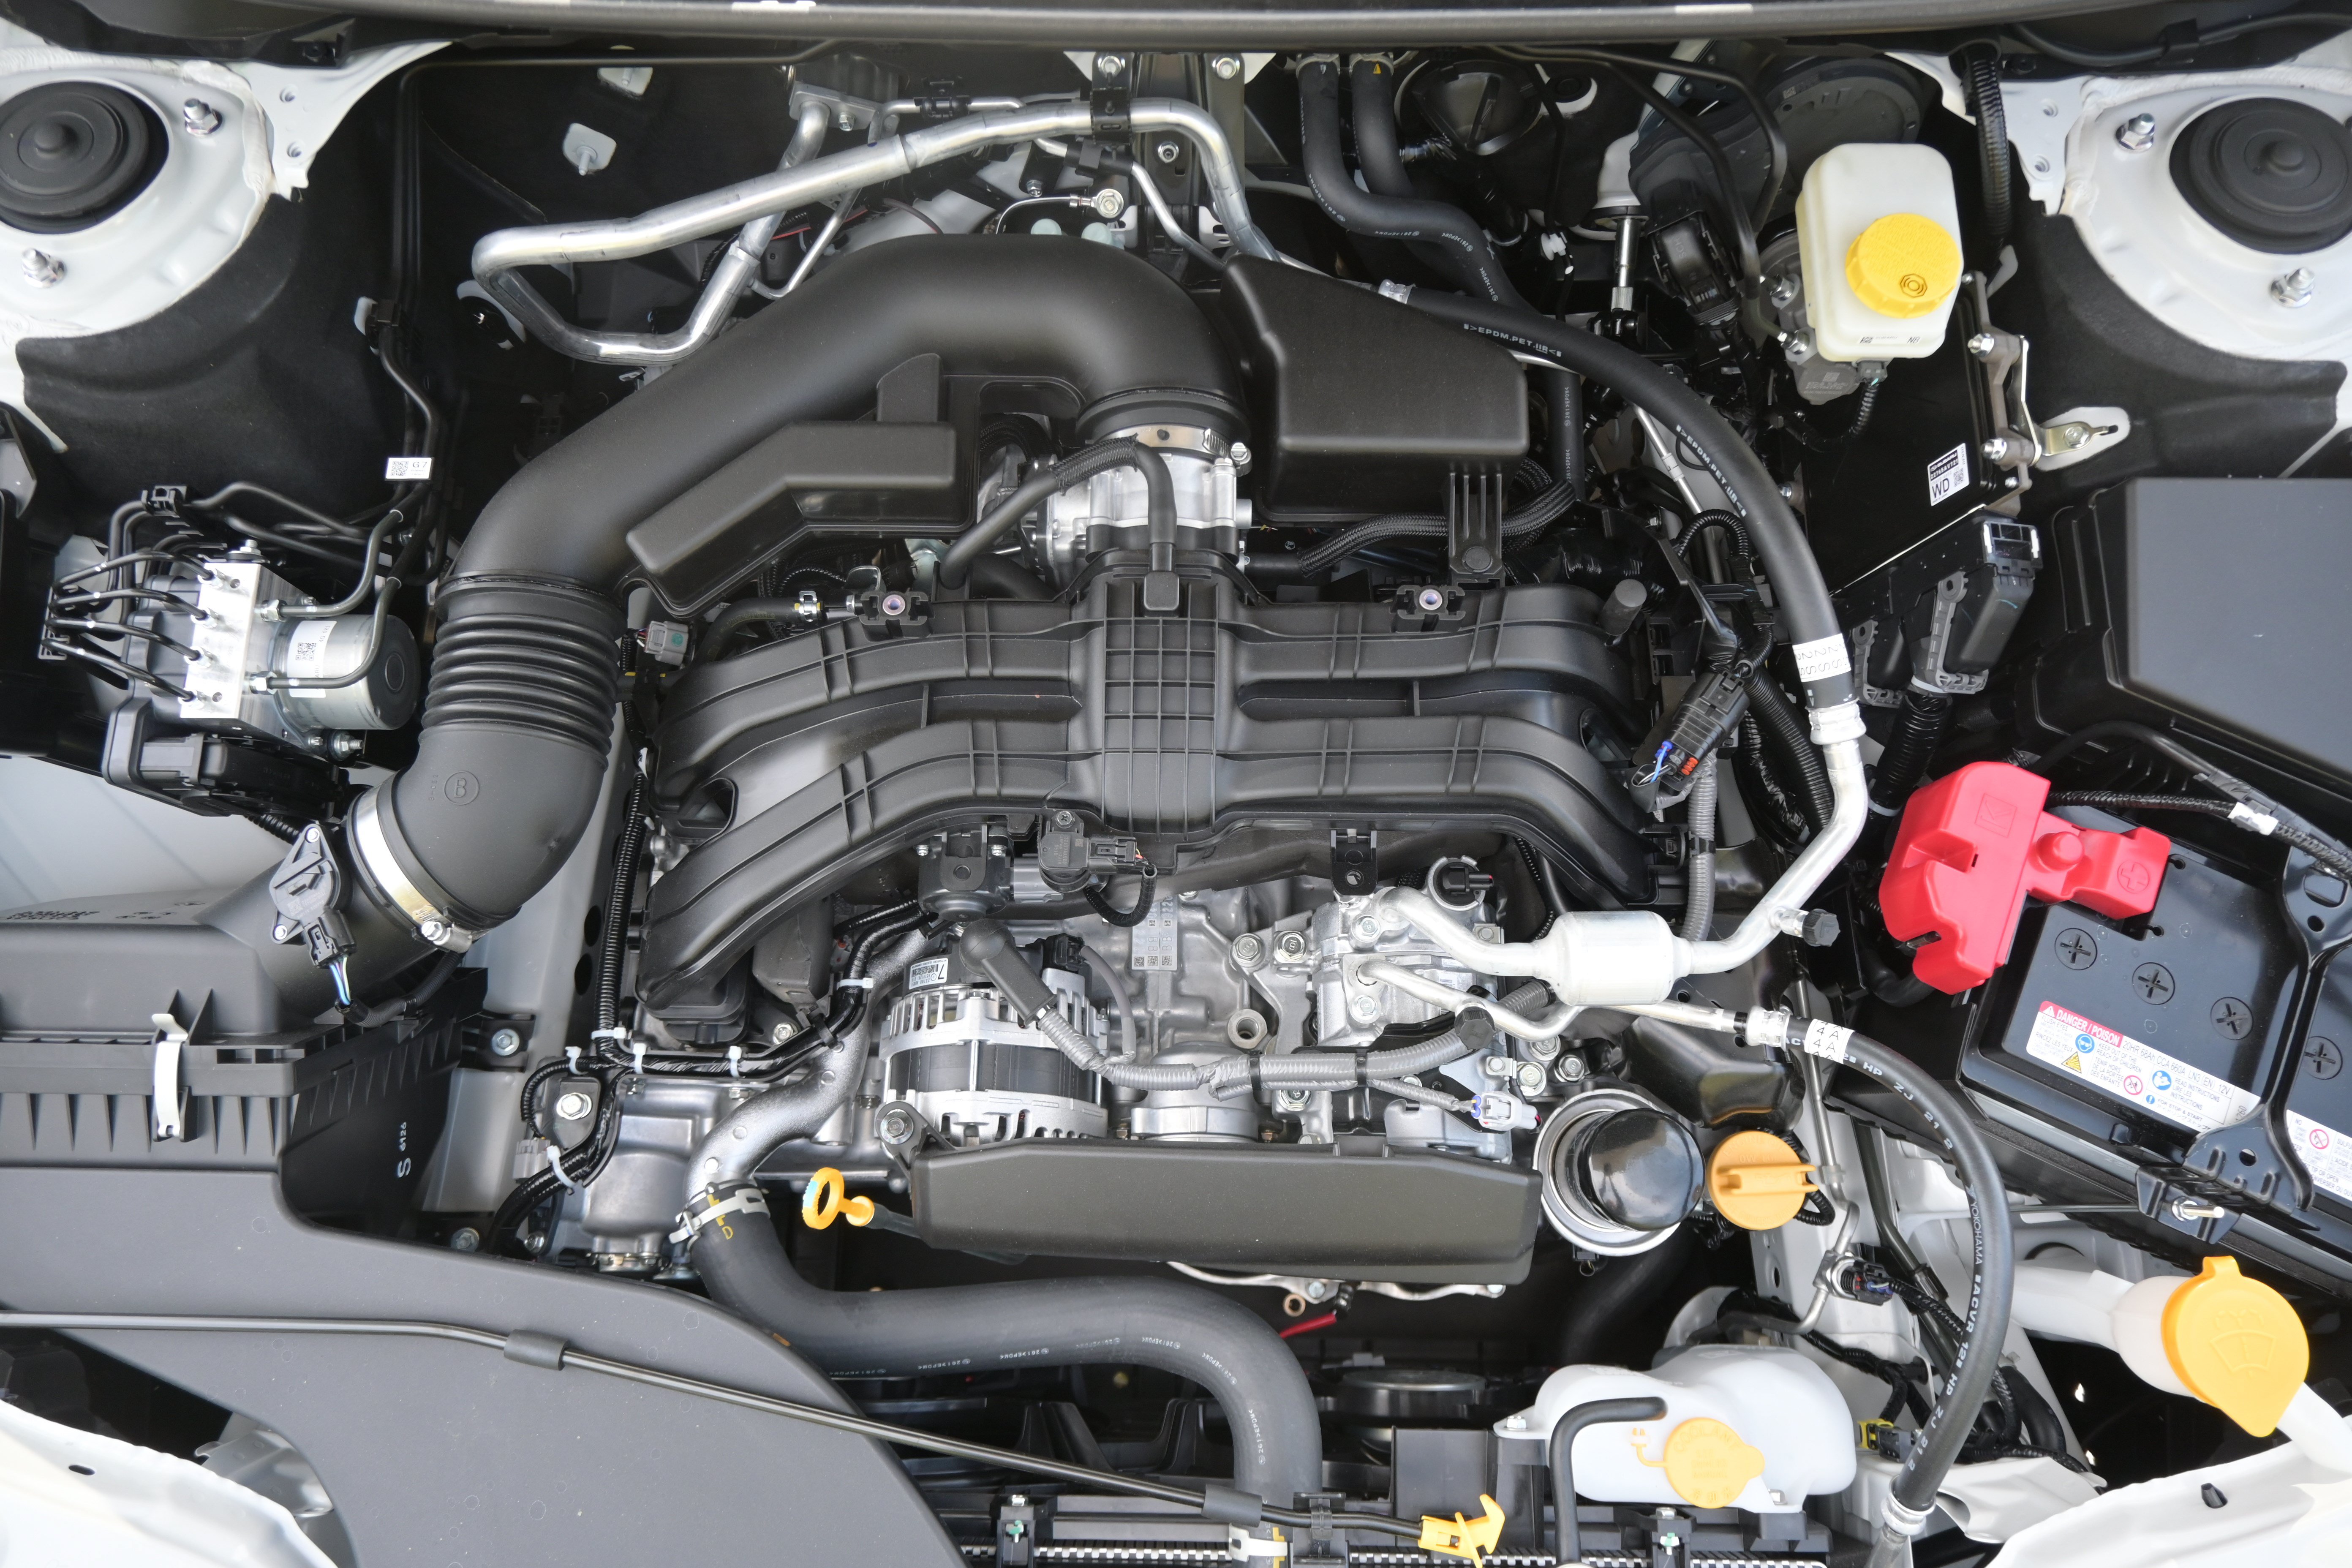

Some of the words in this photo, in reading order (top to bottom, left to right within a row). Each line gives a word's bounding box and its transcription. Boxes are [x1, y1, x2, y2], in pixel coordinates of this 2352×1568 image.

[1932, 478, 1950, 498] WD
[454, 778, 467, 798] B
[937, 964, 945, 980] 7
[2042, 1016, 2055, 1025] FLUSH
[2056, 1010, 2088, 1030] DANGER
[2091, 1026, 2121, 1045] POISON
[2036, 1032, 2051, 1042] RINCEZ
[2095, 1058, 2107, 1066] TENIR
[2109, 1064, 2121, 1072] HORS
[2097, 1050, 2111, 1059] REACH
[2120, 1060, 2142, 1072] CHILDREN
[2123, 1041, 2140, 1053] 20HR
[2140, 1049, 2156, 1061] 68Ah
[2156, 1056, 2170, 1067] CCA
[2171, 1063, 2187, 1075] 660A
[2188, 1071, 2201, 1081] LN3
[2218, 1084, 2230, 1094] 12V
[2100, 1075, 2120, 1086] ENFANTS
[1863, 1062, 1883, 1076] HP
[1924, 1111, 1940, 1129] 21
[2170, 1092, 2203, 1109] INSTRUCTIONS
[2188, 1084, 2220, 1101] INSTRUCTIONS
[2157, 1104, 2210, 1130] アイドリングストップ
[2188, 1113, 2202, 1121] START
[397, 1157, 411, 1178] S
[2311, 1175, 2336, 1189] ENVERSER
[2327, 1174, 2339, 1182] OPEN
[1971, 1201, 1983, 1265] YOKOHAMA
[1946, 1373, 1958, 1396] HP
[1674, 1424, 1741, 1453] COOLANT
